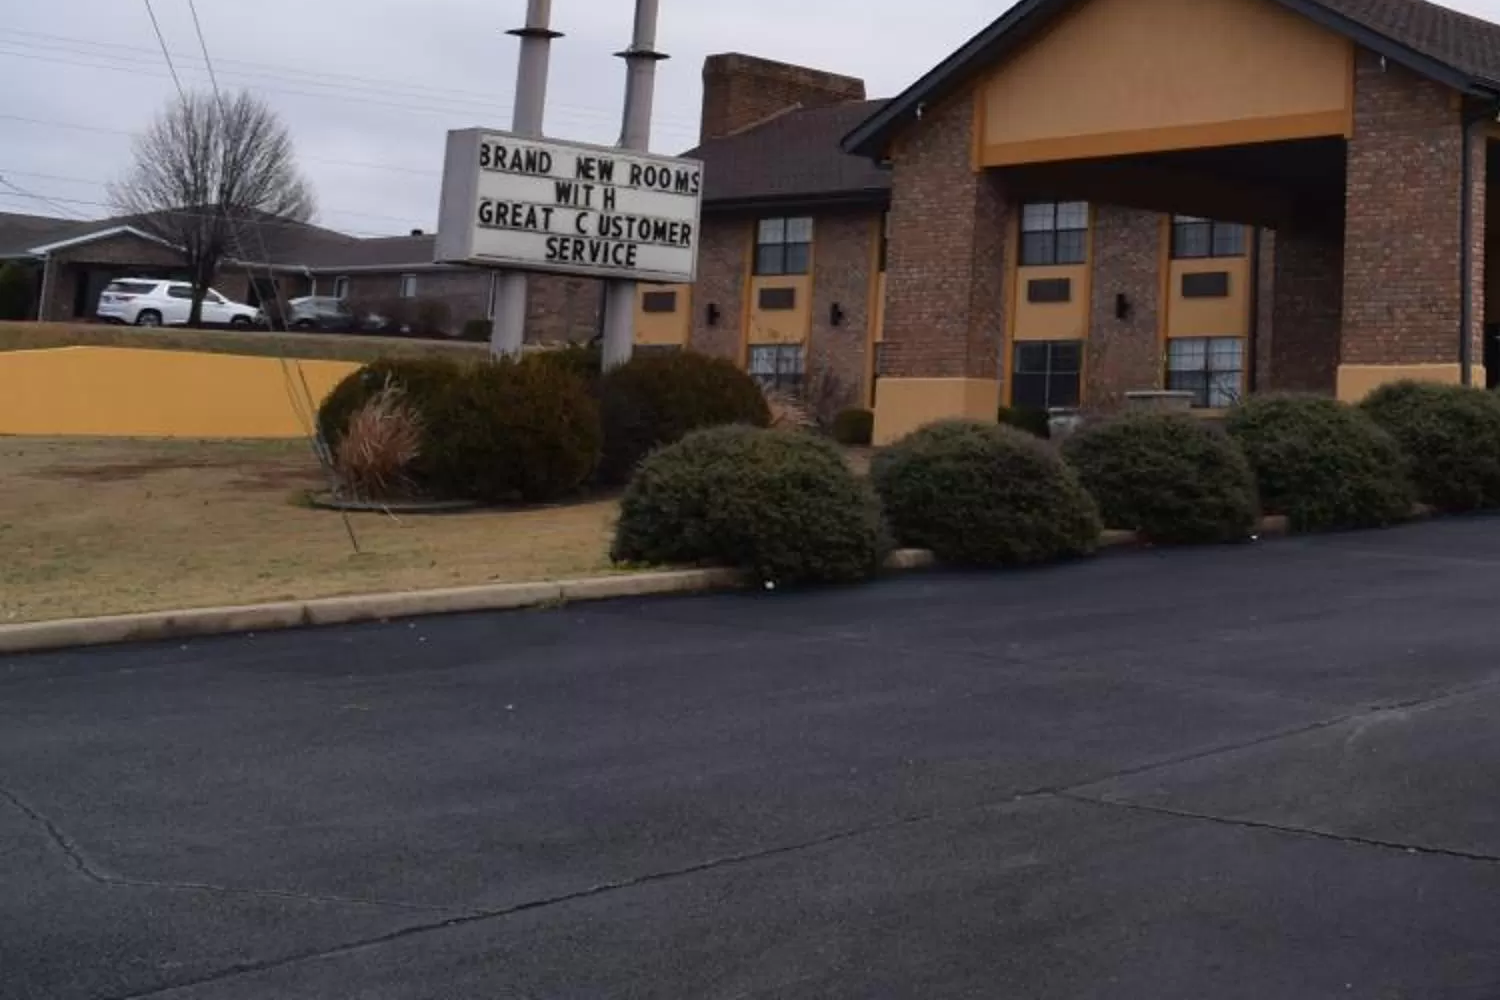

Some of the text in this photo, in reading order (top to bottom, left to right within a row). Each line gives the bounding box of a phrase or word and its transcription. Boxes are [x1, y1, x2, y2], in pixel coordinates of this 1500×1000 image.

[480, 143, 700, 193] BRAND NEW ROOMS
[555, 182, 616, 210] WITH
[479, 201, 554, 230] GREAT
[545, 237, 637, 266] SERVICE
